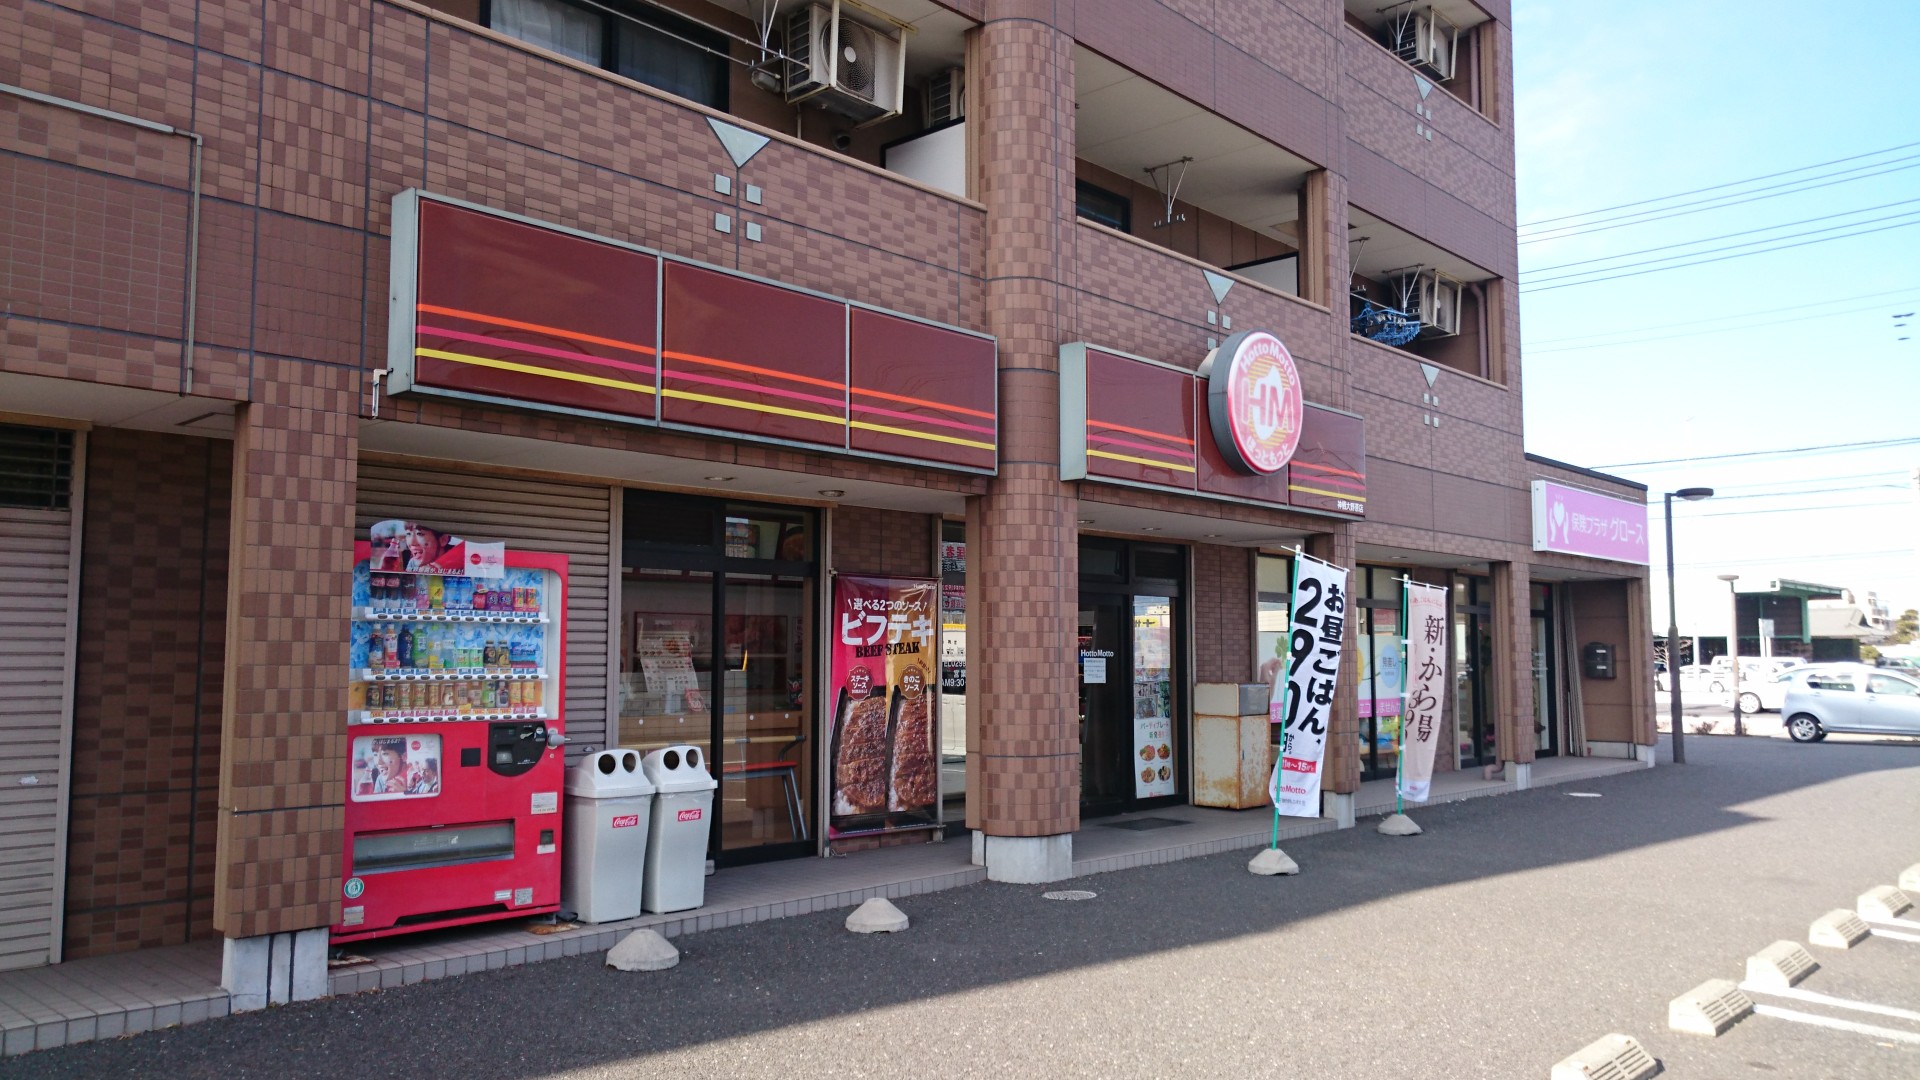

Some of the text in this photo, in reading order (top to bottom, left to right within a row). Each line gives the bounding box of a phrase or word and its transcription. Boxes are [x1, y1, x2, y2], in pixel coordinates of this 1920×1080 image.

[1241, 377, 1295, 433] HM
[1609, 517, 1645, 545] グロース
[853, 598, 922, 611] 選べる2つのソース
[842, 611, 934, 647] ビフテキ
[855, 641, 920, 658] BEEF STEAK
[1080, 649, 1114, 657] HottoMotto
[903, 675, 921, 683] きのこ
